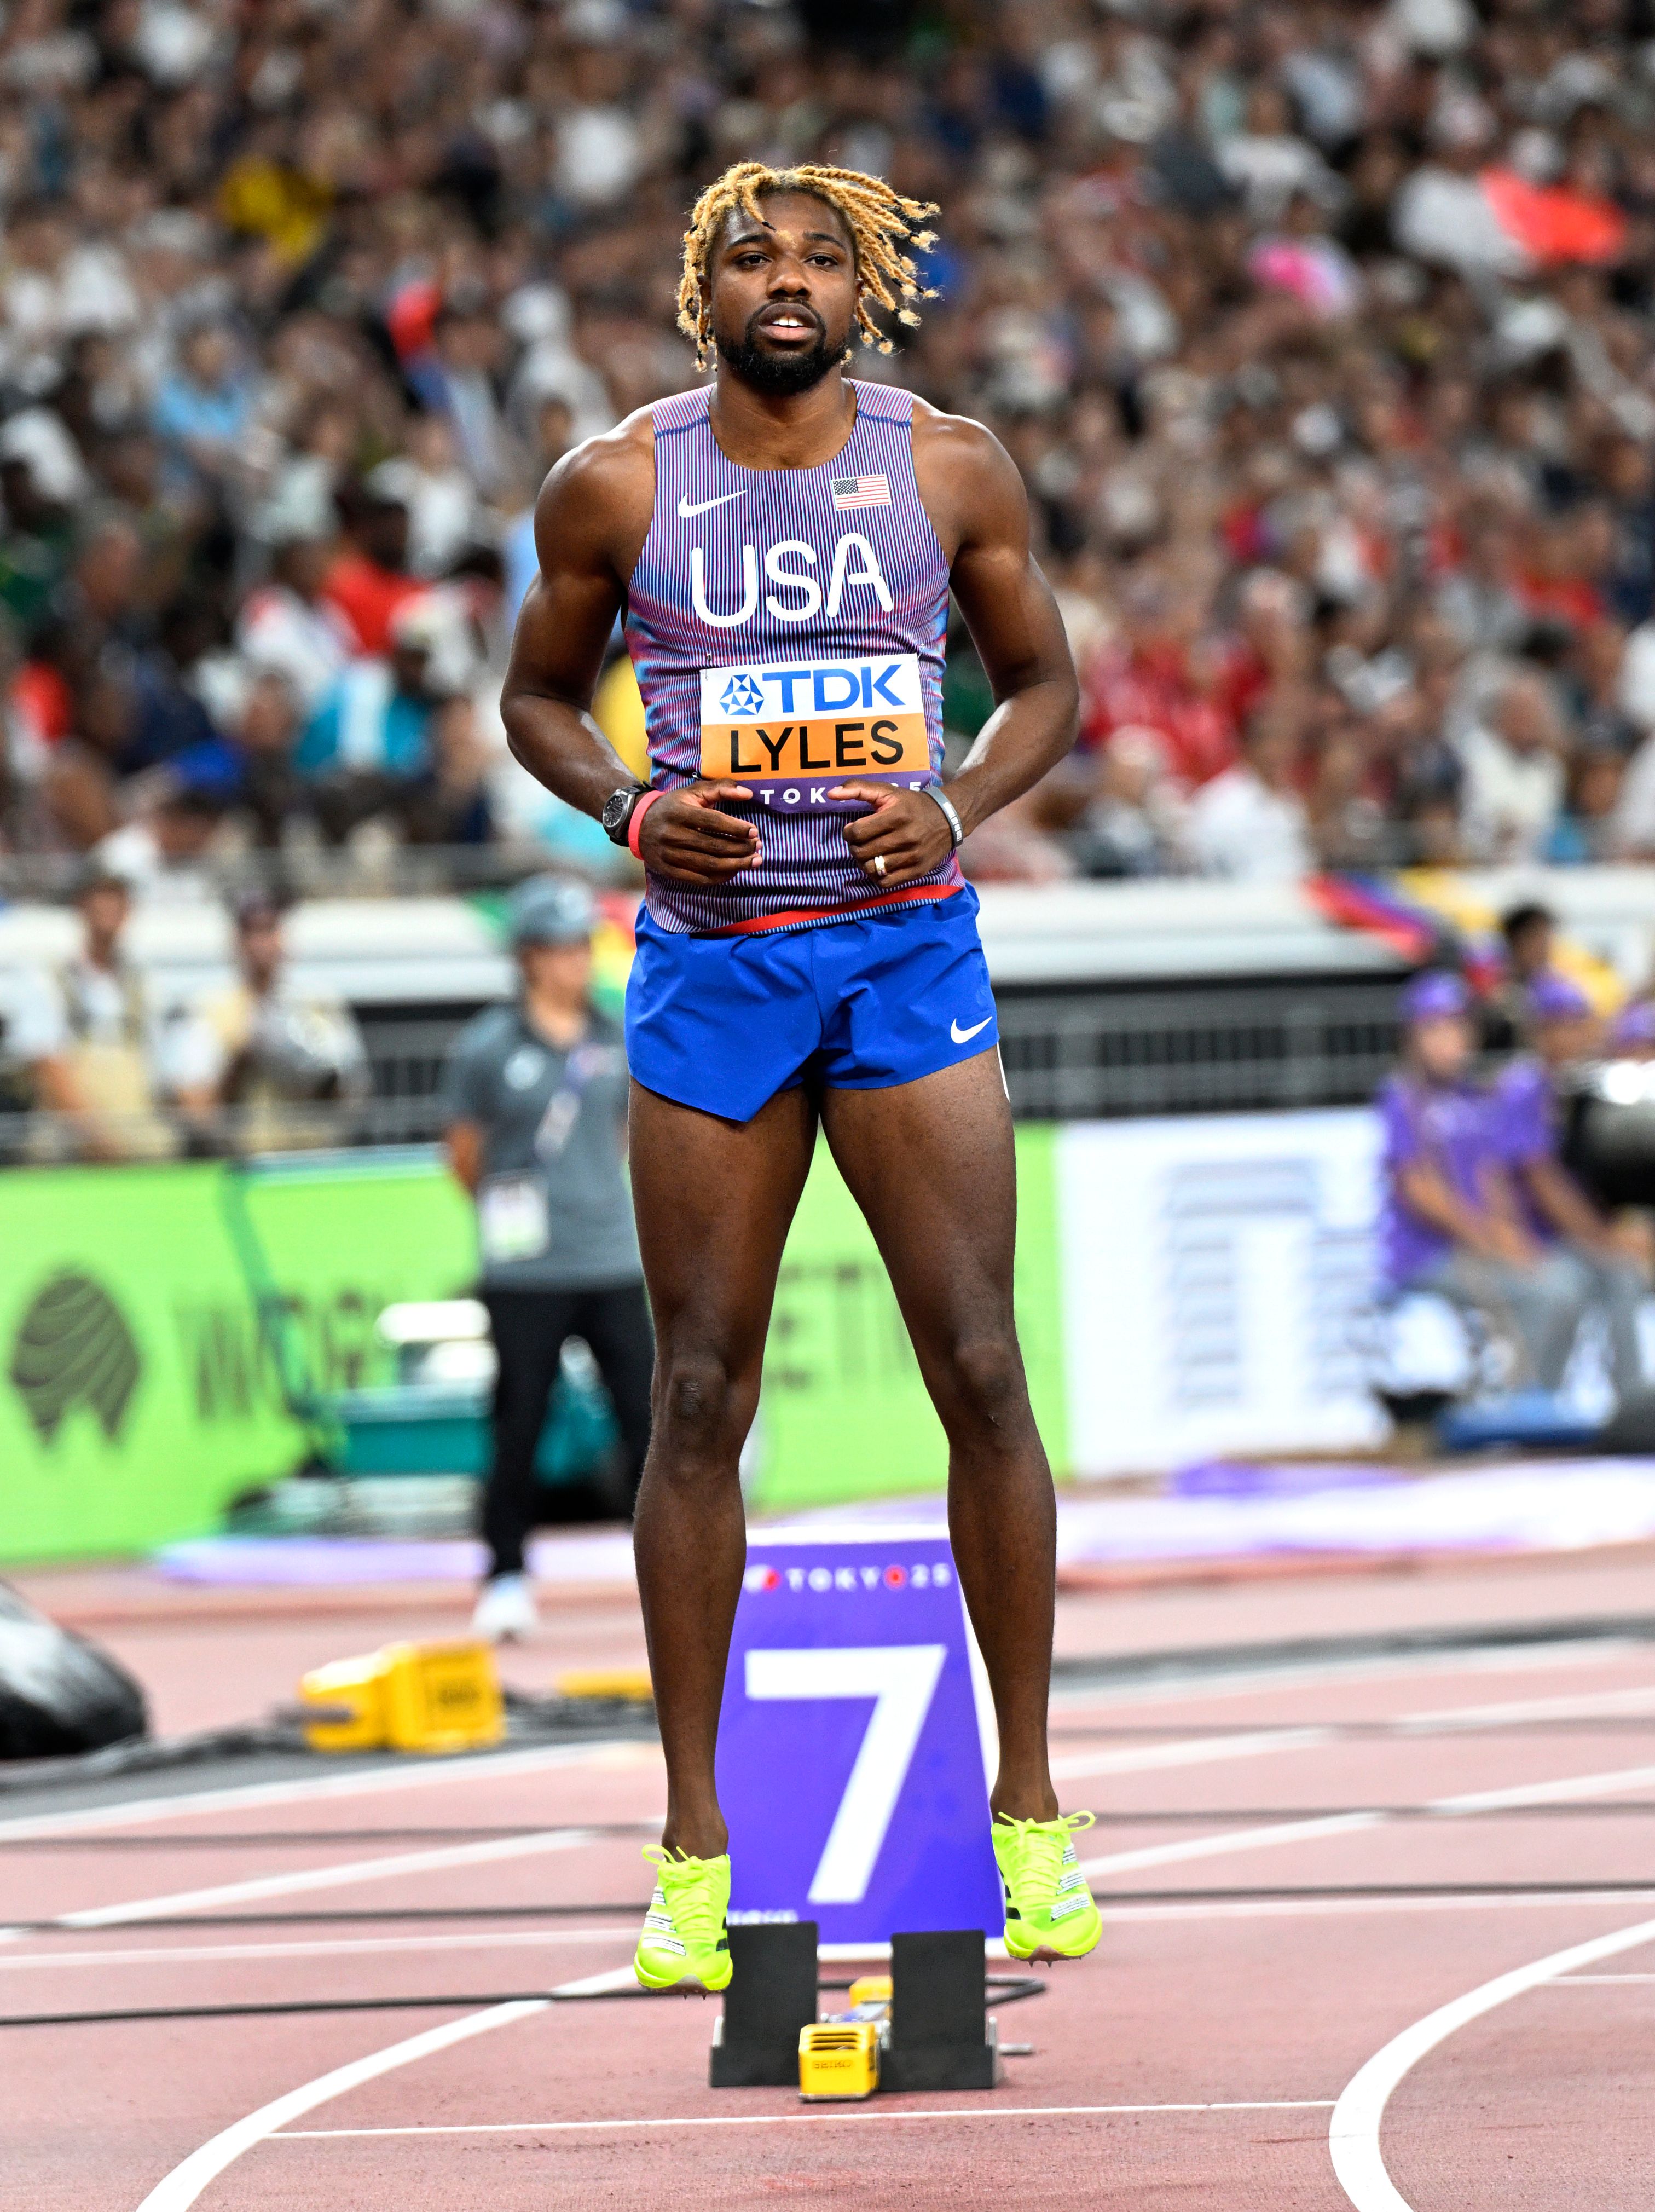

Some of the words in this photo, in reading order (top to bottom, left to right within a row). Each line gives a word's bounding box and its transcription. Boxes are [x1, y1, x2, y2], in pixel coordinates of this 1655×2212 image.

[691, 532, 894, 628] USA
[762, 664, 906, 713] TDK
[731, 720, 904, 773] LYLES
[744, 1643, 947, 1904] 7
[813, 2060, 852, 2069] SEIKO
